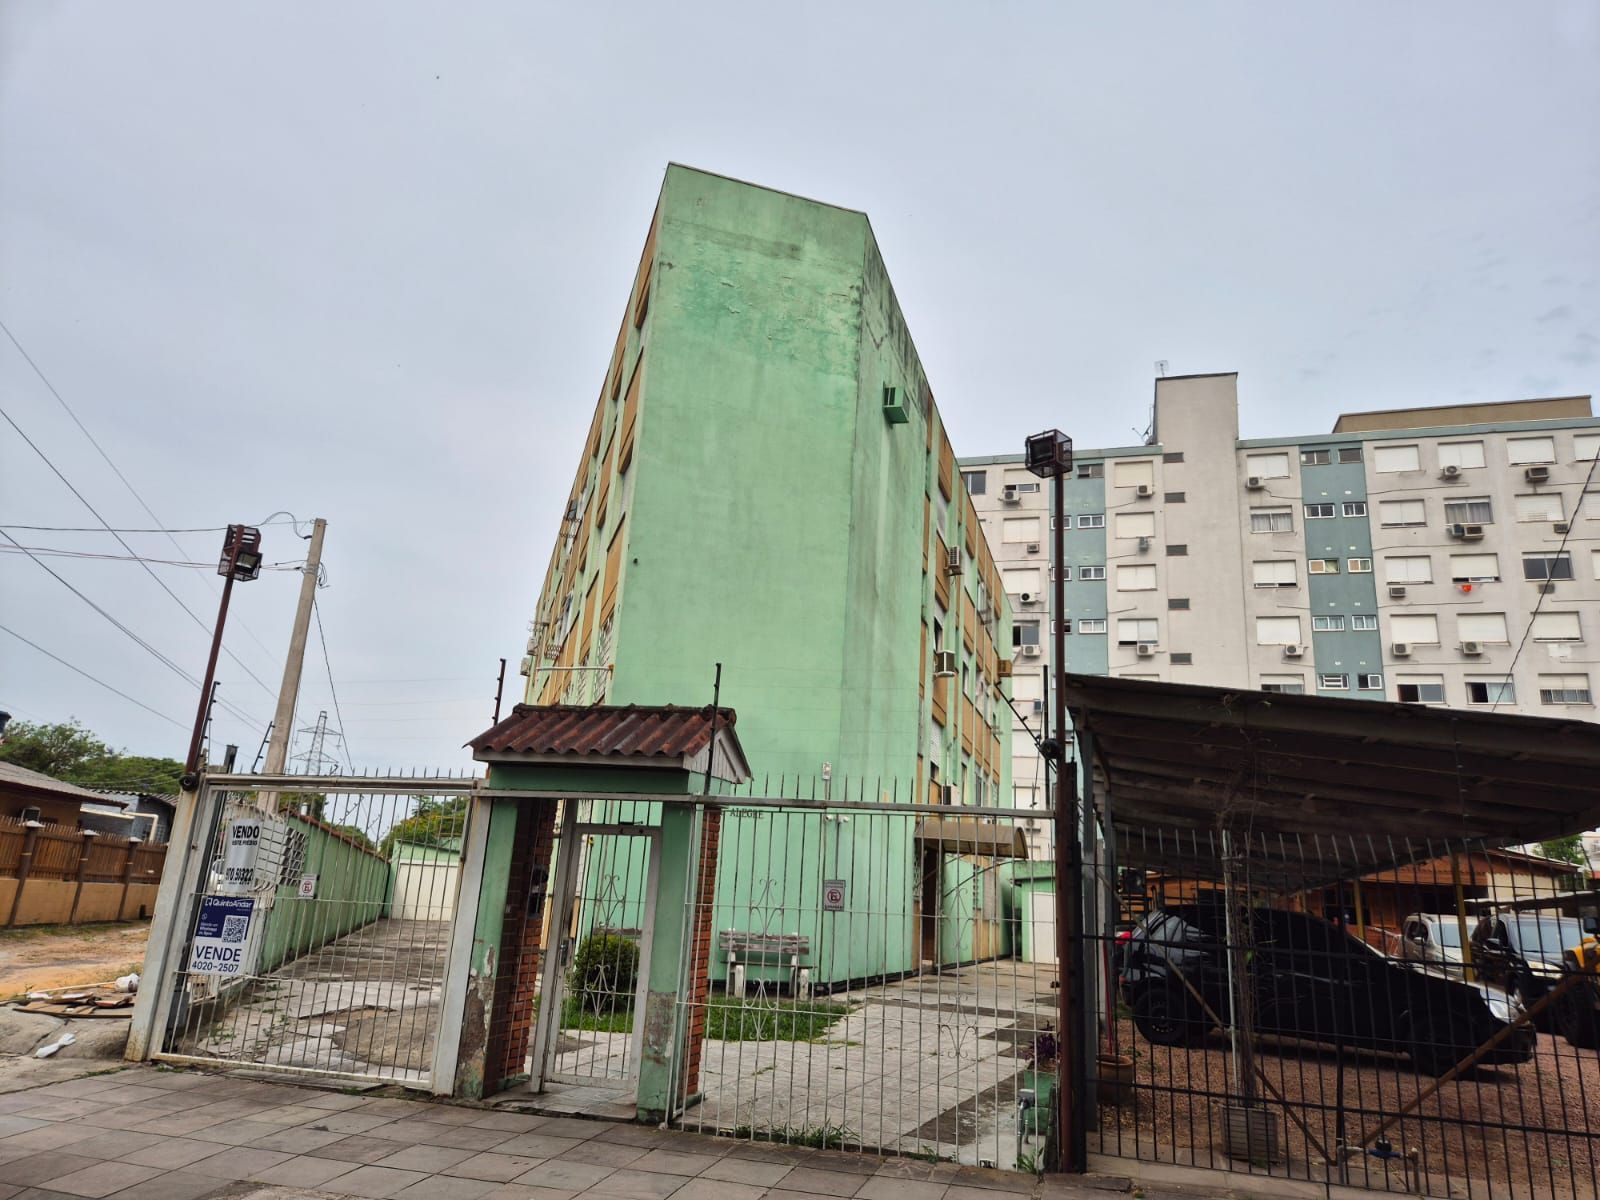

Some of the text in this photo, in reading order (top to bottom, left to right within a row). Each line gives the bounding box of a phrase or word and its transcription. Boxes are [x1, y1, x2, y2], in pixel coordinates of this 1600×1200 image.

[232, 825, 260, 839] VENDO
[213, 898, 252, 908] QuintoAndar
[196, 945, 241, 962] VENDE
[192, 960, 239, 972] 4020-2507
